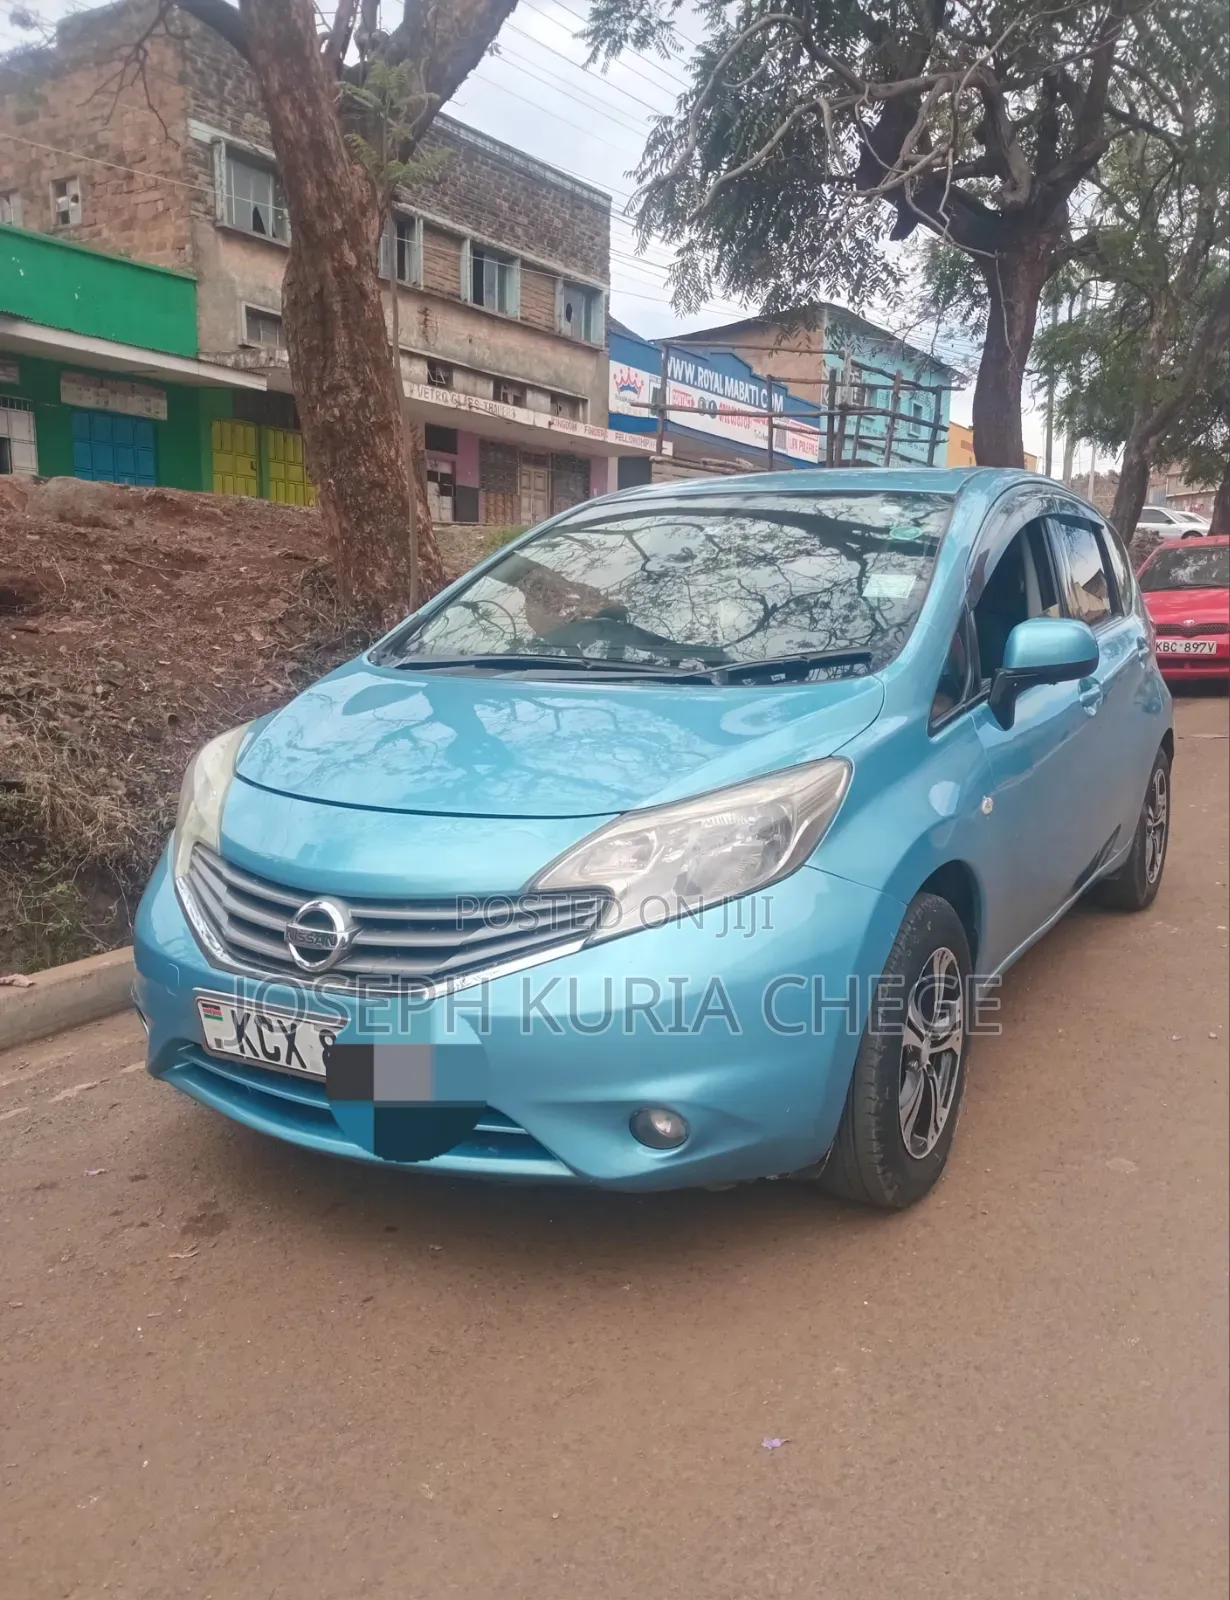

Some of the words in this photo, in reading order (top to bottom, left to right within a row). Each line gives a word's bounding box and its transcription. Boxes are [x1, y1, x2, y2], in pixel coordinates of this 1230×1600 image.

[417, 384, 449, 403] VETRO
[551, 417, 578, 433] KINGDOM
[584, 425, 609, 441] FINDERS
[614, 432, 650, 449] FELLOWSHIP
[1155, 641, 1178, 652] KBC
[1184, 642, 1215, 653] 897V
[286, 929, 338, 949] NISSAN
[231, 1009, 307, 1069] KCX
